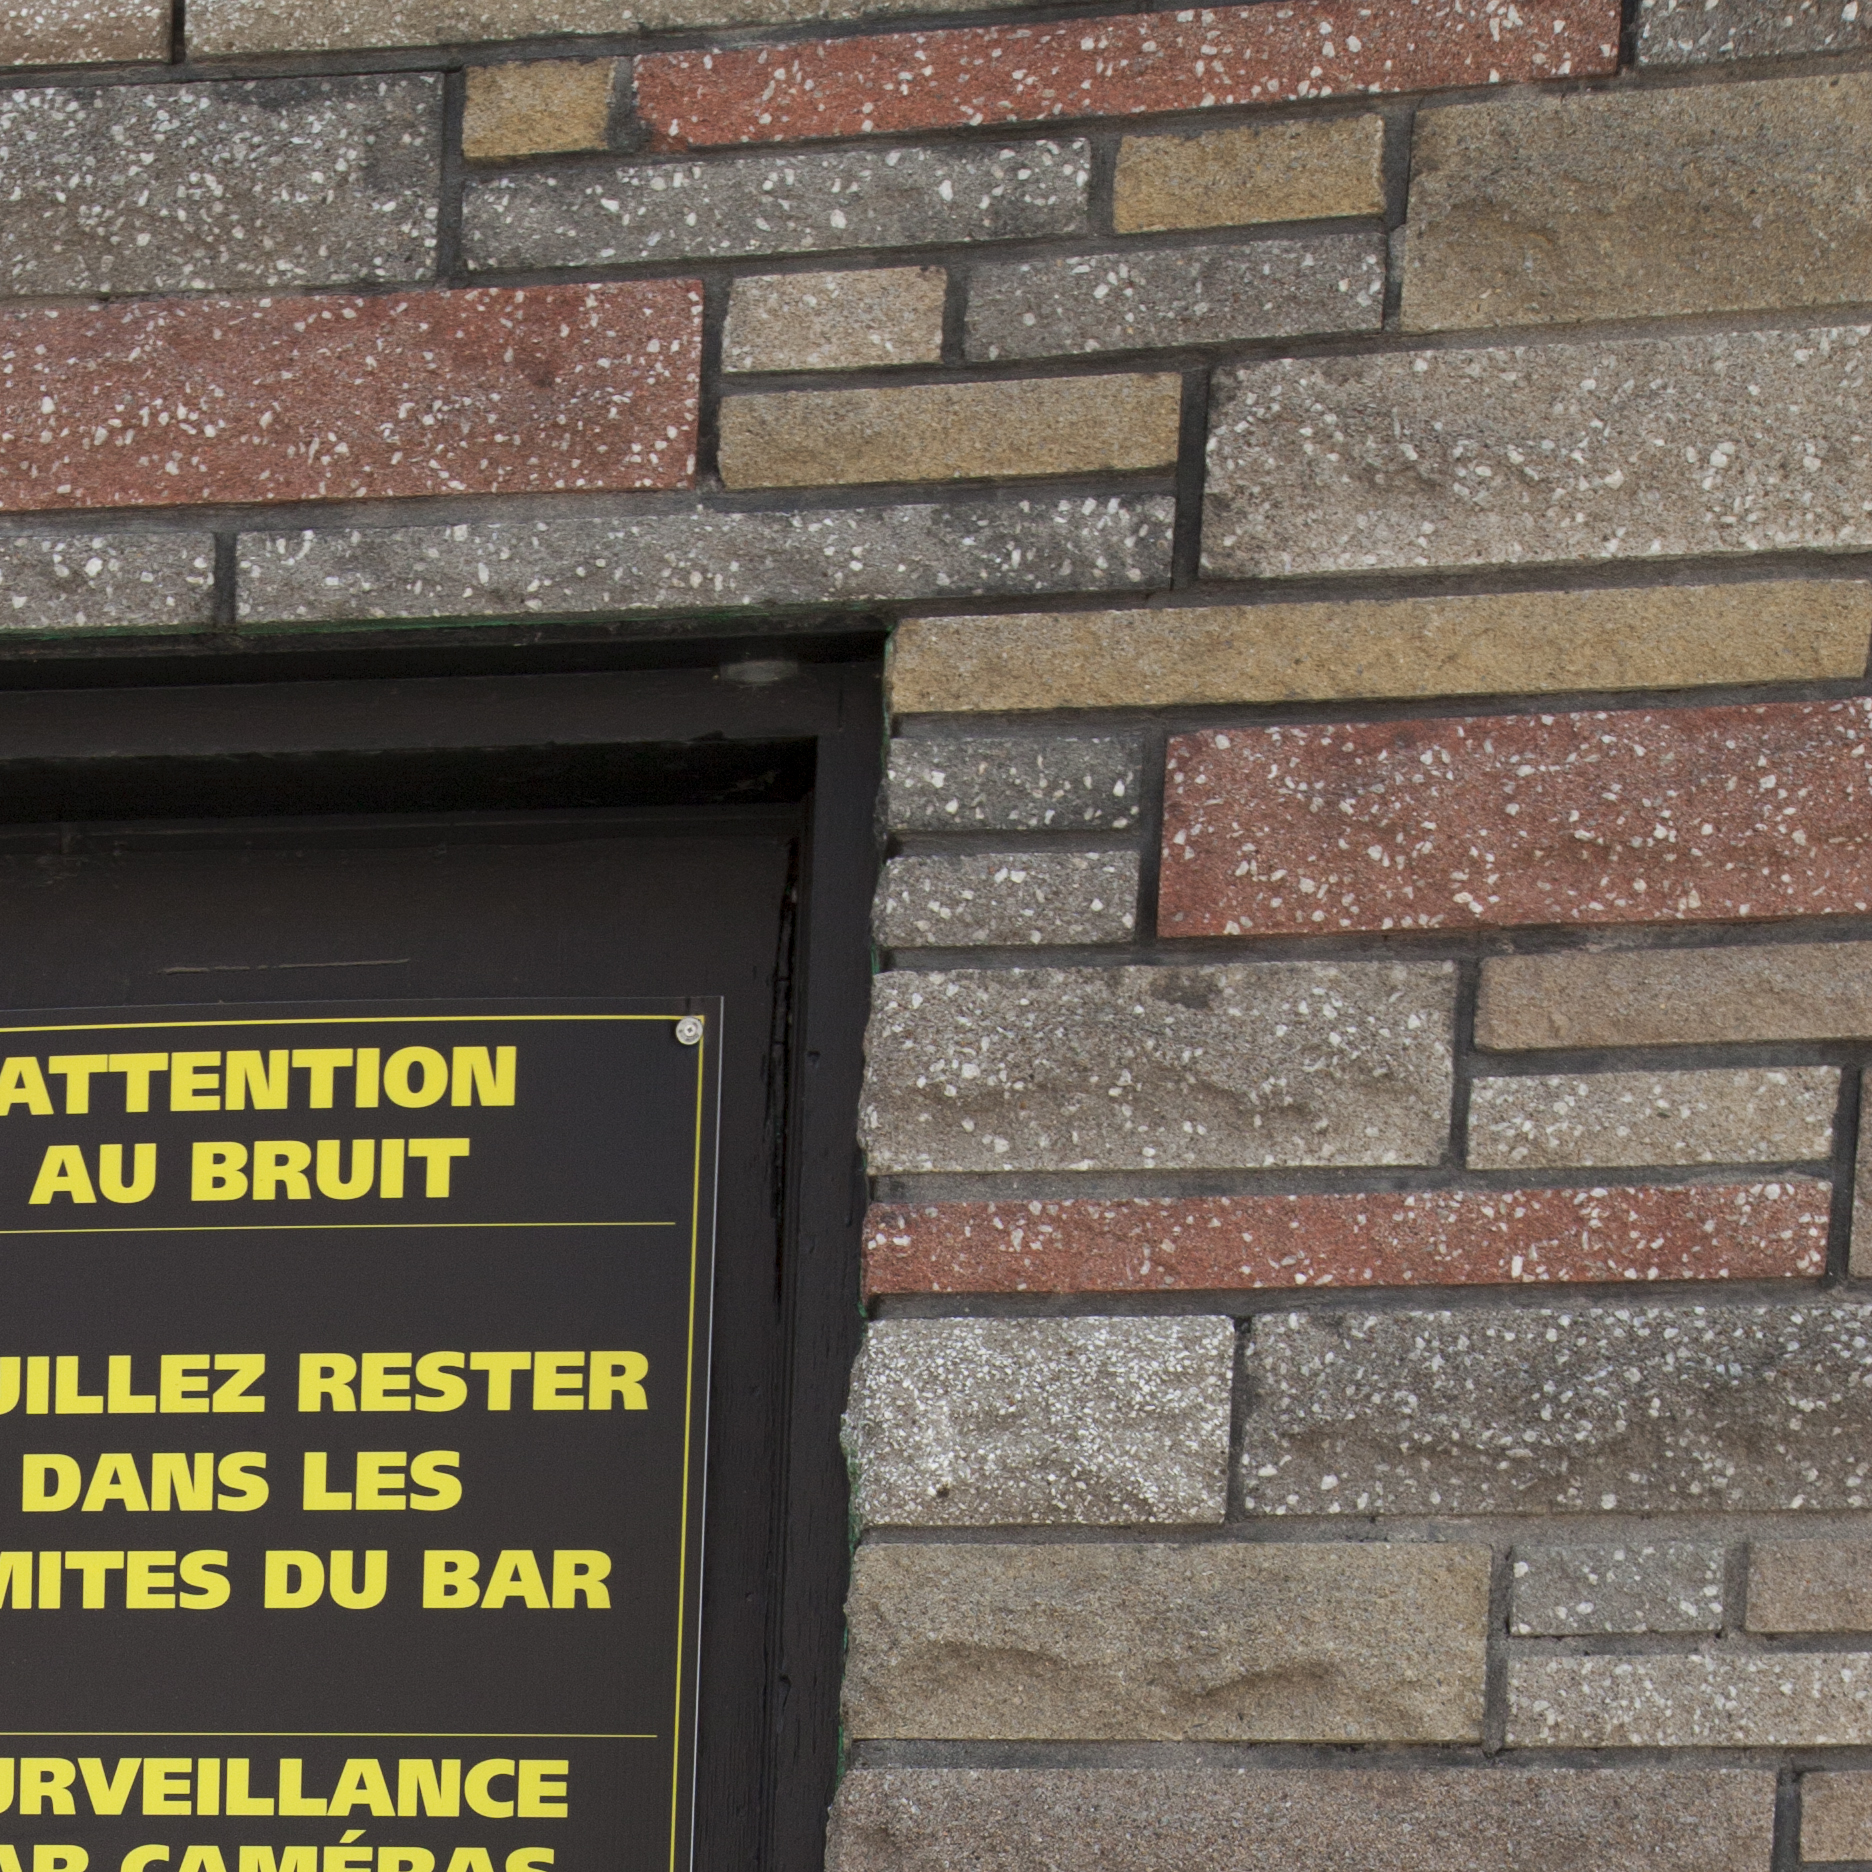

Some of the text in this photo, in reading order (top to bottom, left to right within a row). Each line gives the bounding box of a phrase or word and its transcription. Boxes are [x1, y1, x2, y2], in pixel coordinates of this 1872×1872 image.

[29, 1138, 470, 1204] AU BRUIT
[298, 1351, 648, 1412] RESTER
[22, 1450, 462, 1512] DANS LES
[264, 1550, 388, 1609] DU
[423, 1550, 611, 1608] BAR
